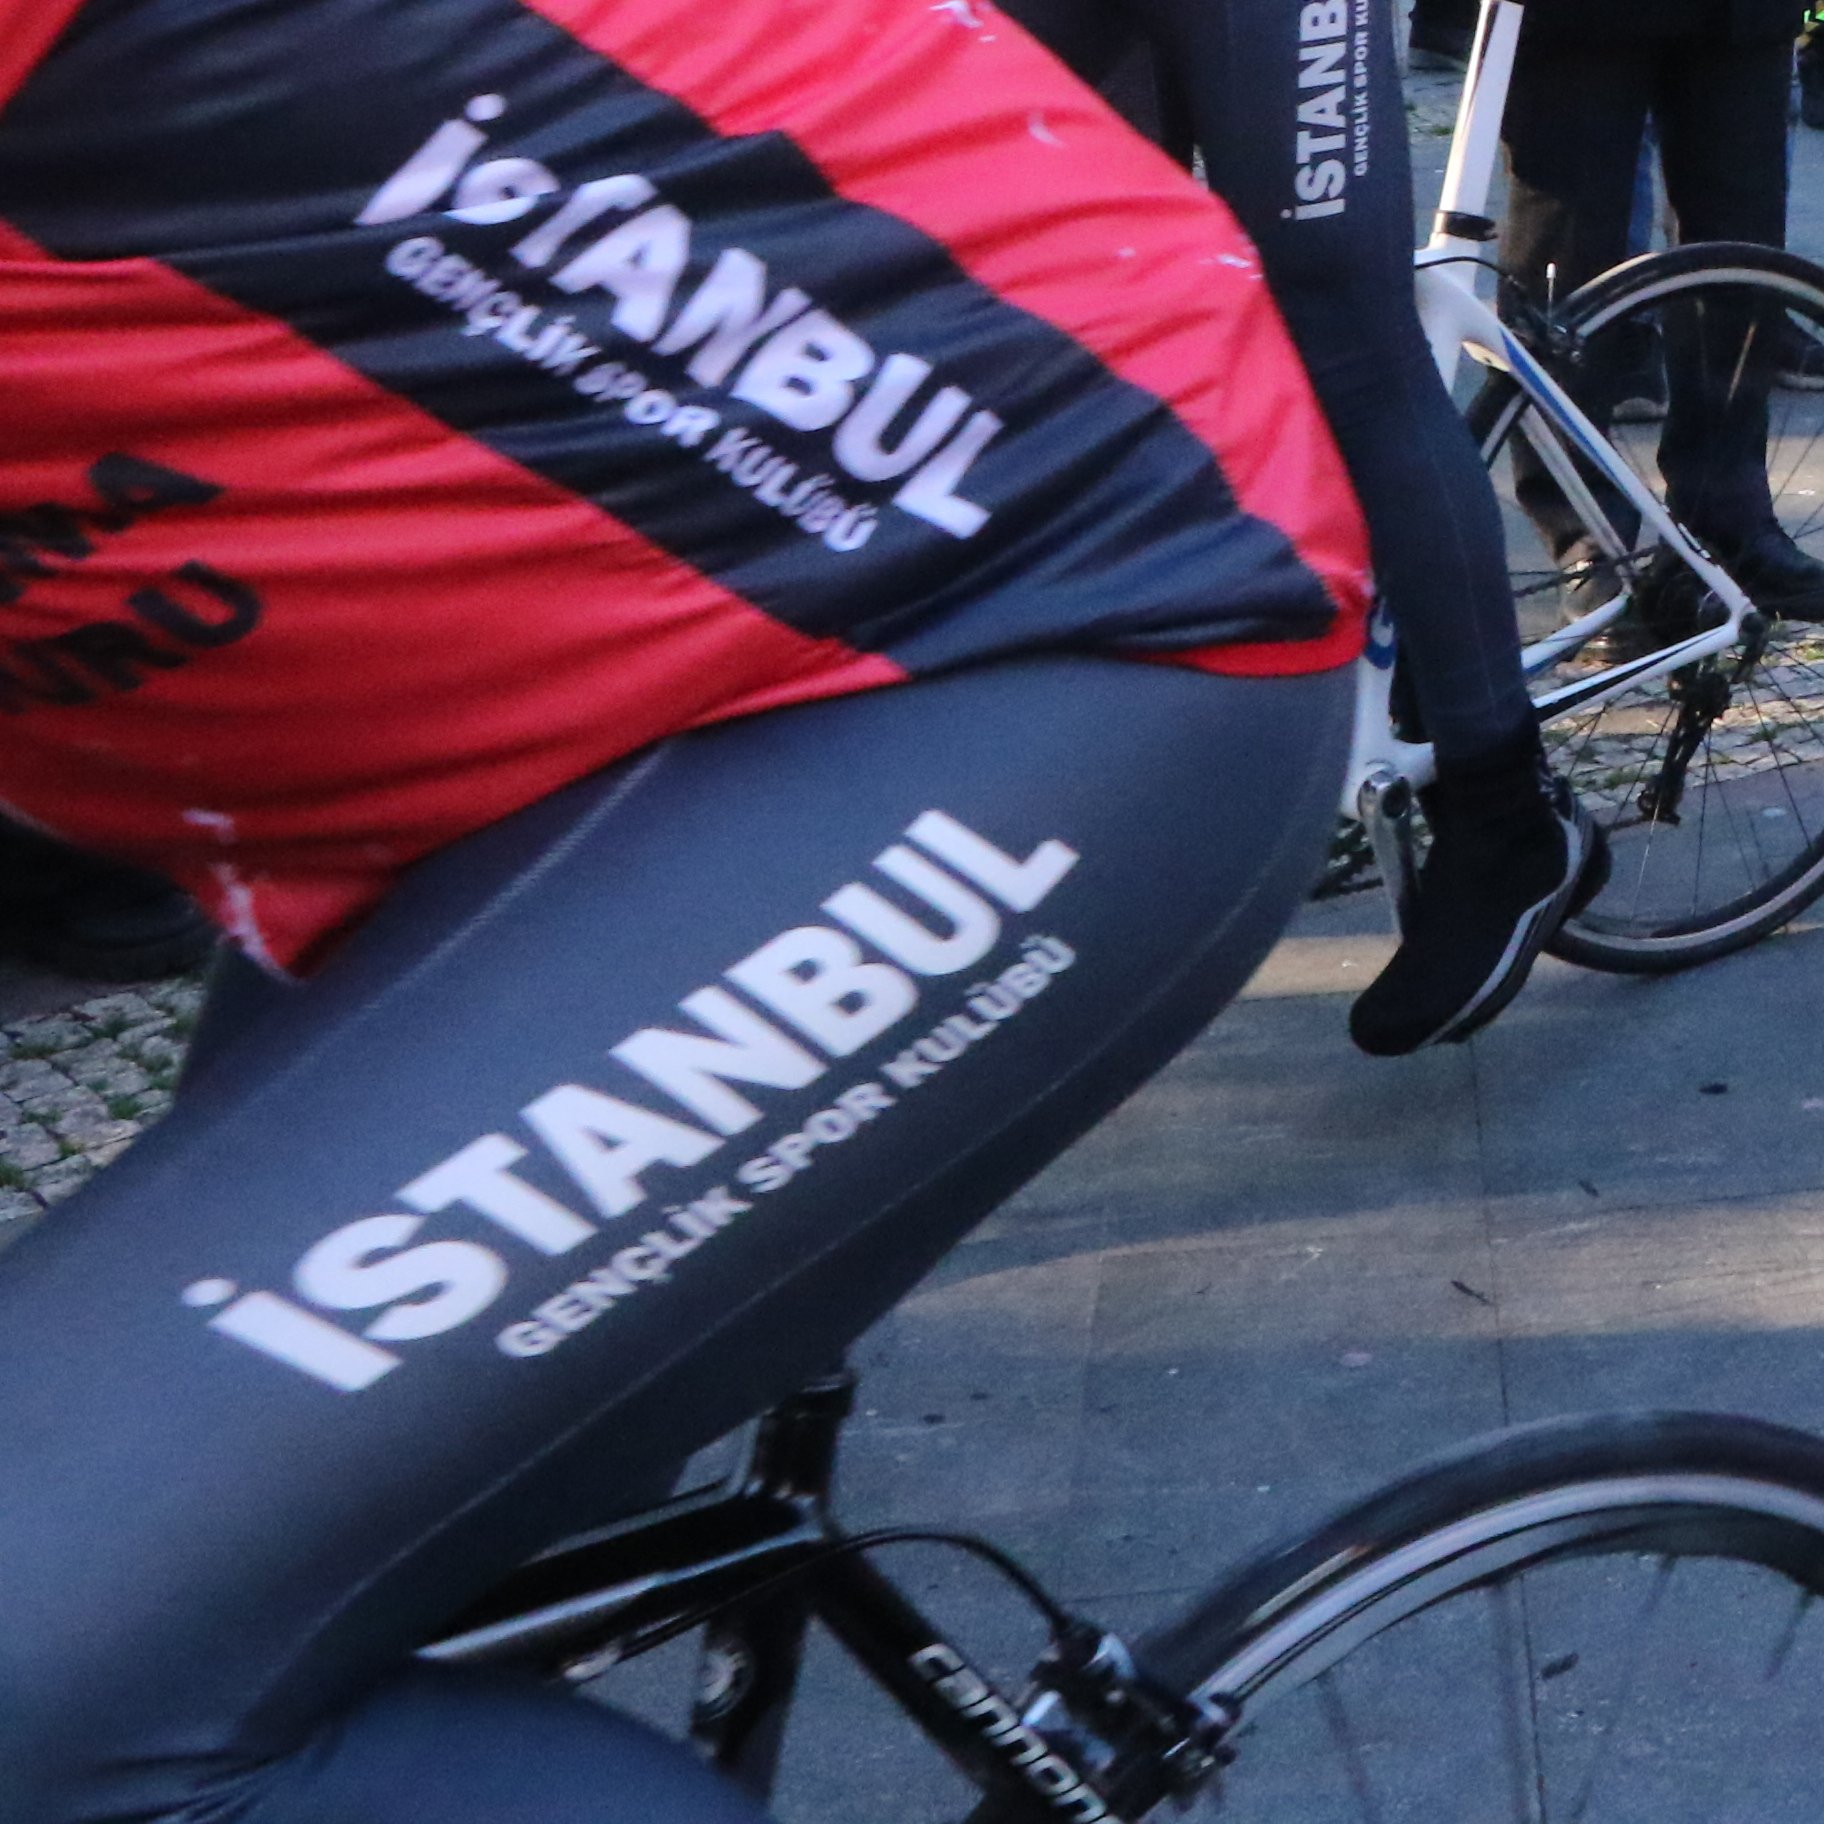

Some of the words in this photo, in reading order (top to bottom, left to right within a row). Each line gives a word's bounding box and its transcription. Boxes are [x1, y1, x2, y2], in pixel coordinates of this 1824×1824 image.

[1353, 91, 1370, 176] GENÇLİK
[1356, 30, 1370, 89] SPOR
[354, 93, 1004, 540] İSTANBUL
[182, 809, 1080, 1392] İSTANBUL
[496, 1181, 750, 1360] GENÇLİK
[738, 1082, 892, 1194] SPOR
[882, 932, 1078, 1094] KULÜBÜ
